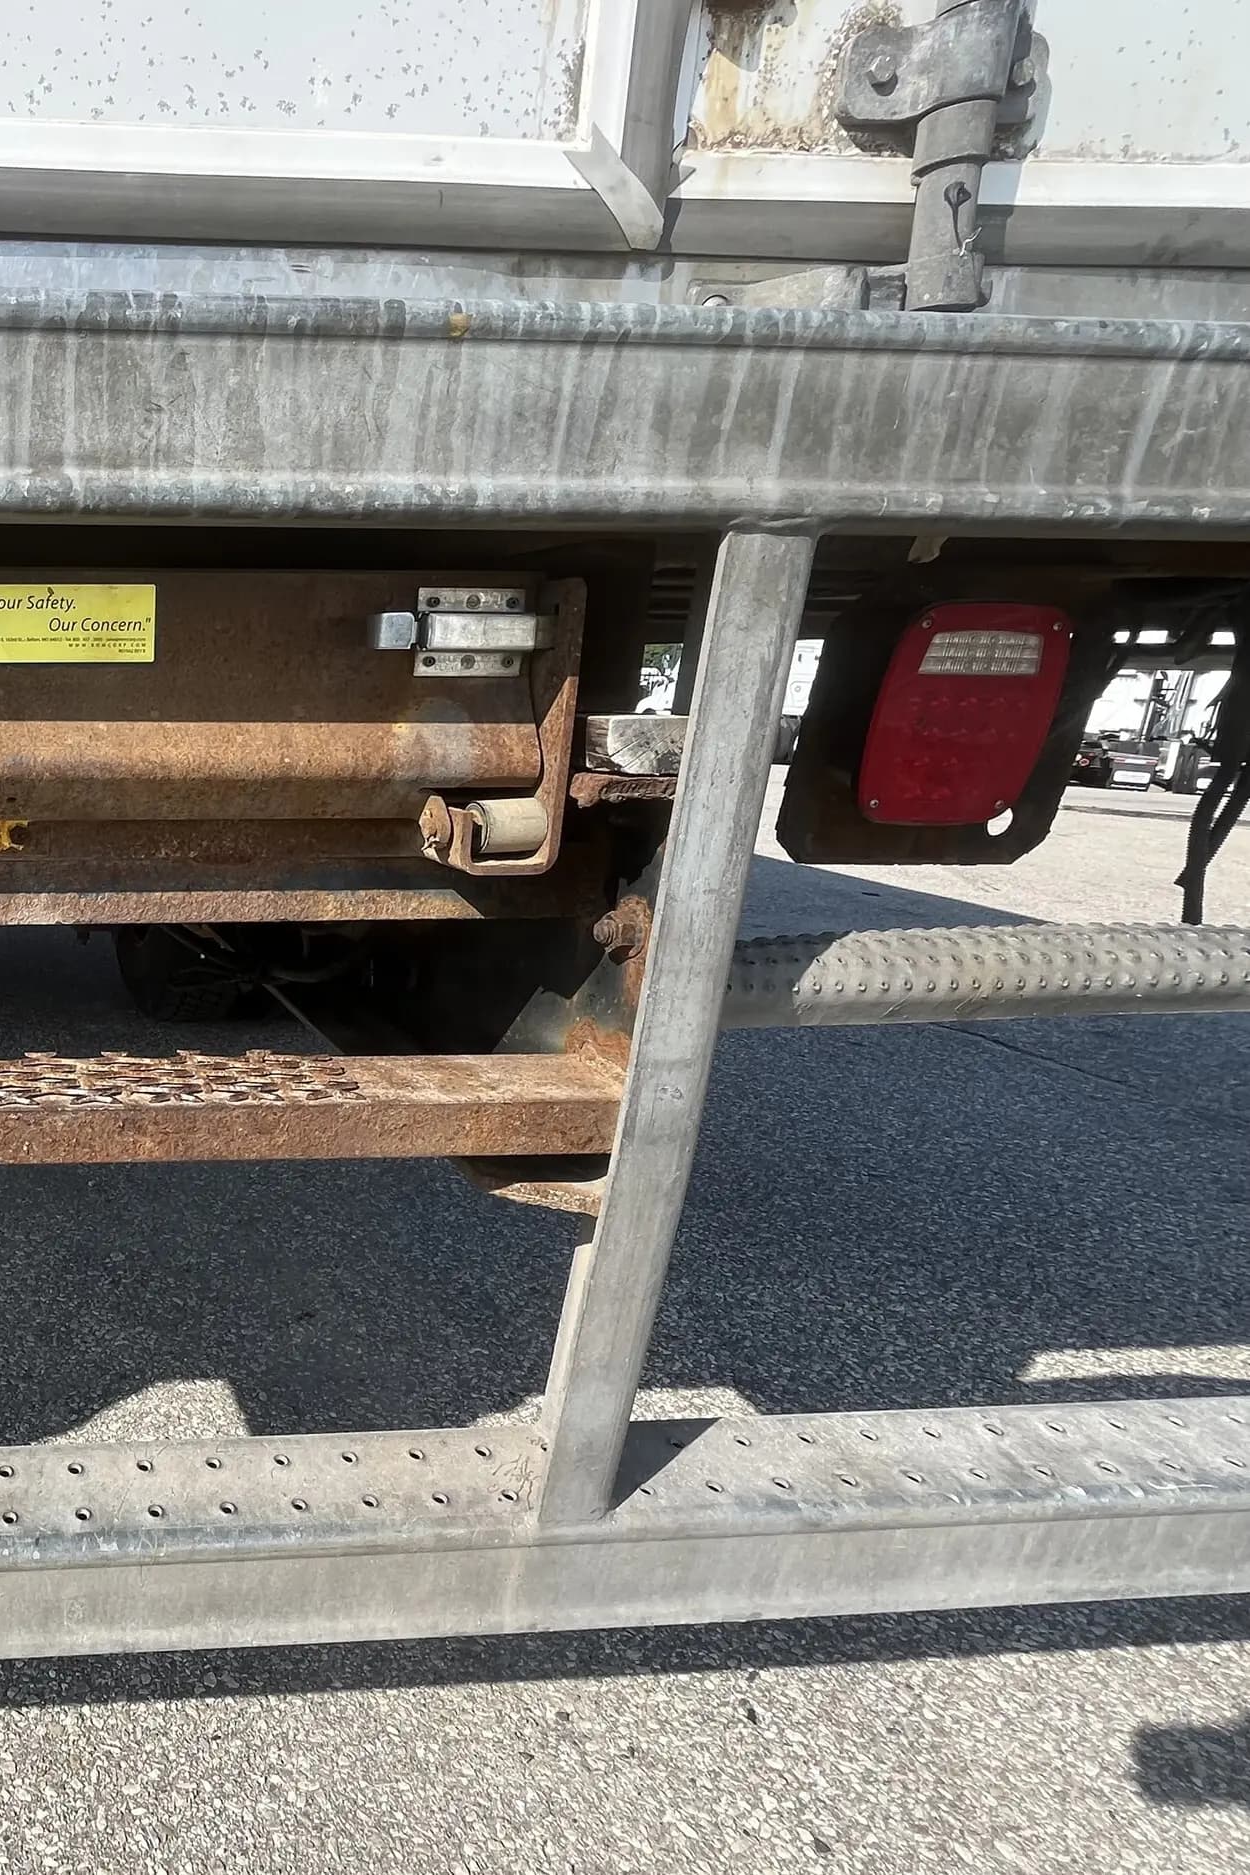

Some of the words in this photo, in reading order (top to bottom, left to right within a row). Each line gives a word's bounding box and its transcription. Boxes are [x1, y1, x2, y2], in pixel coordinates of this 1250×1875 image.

[26, 595, 76, 613] Safety.
[49, 618, 78, 632] Our
[81, 617, 151, 632] Concern."
